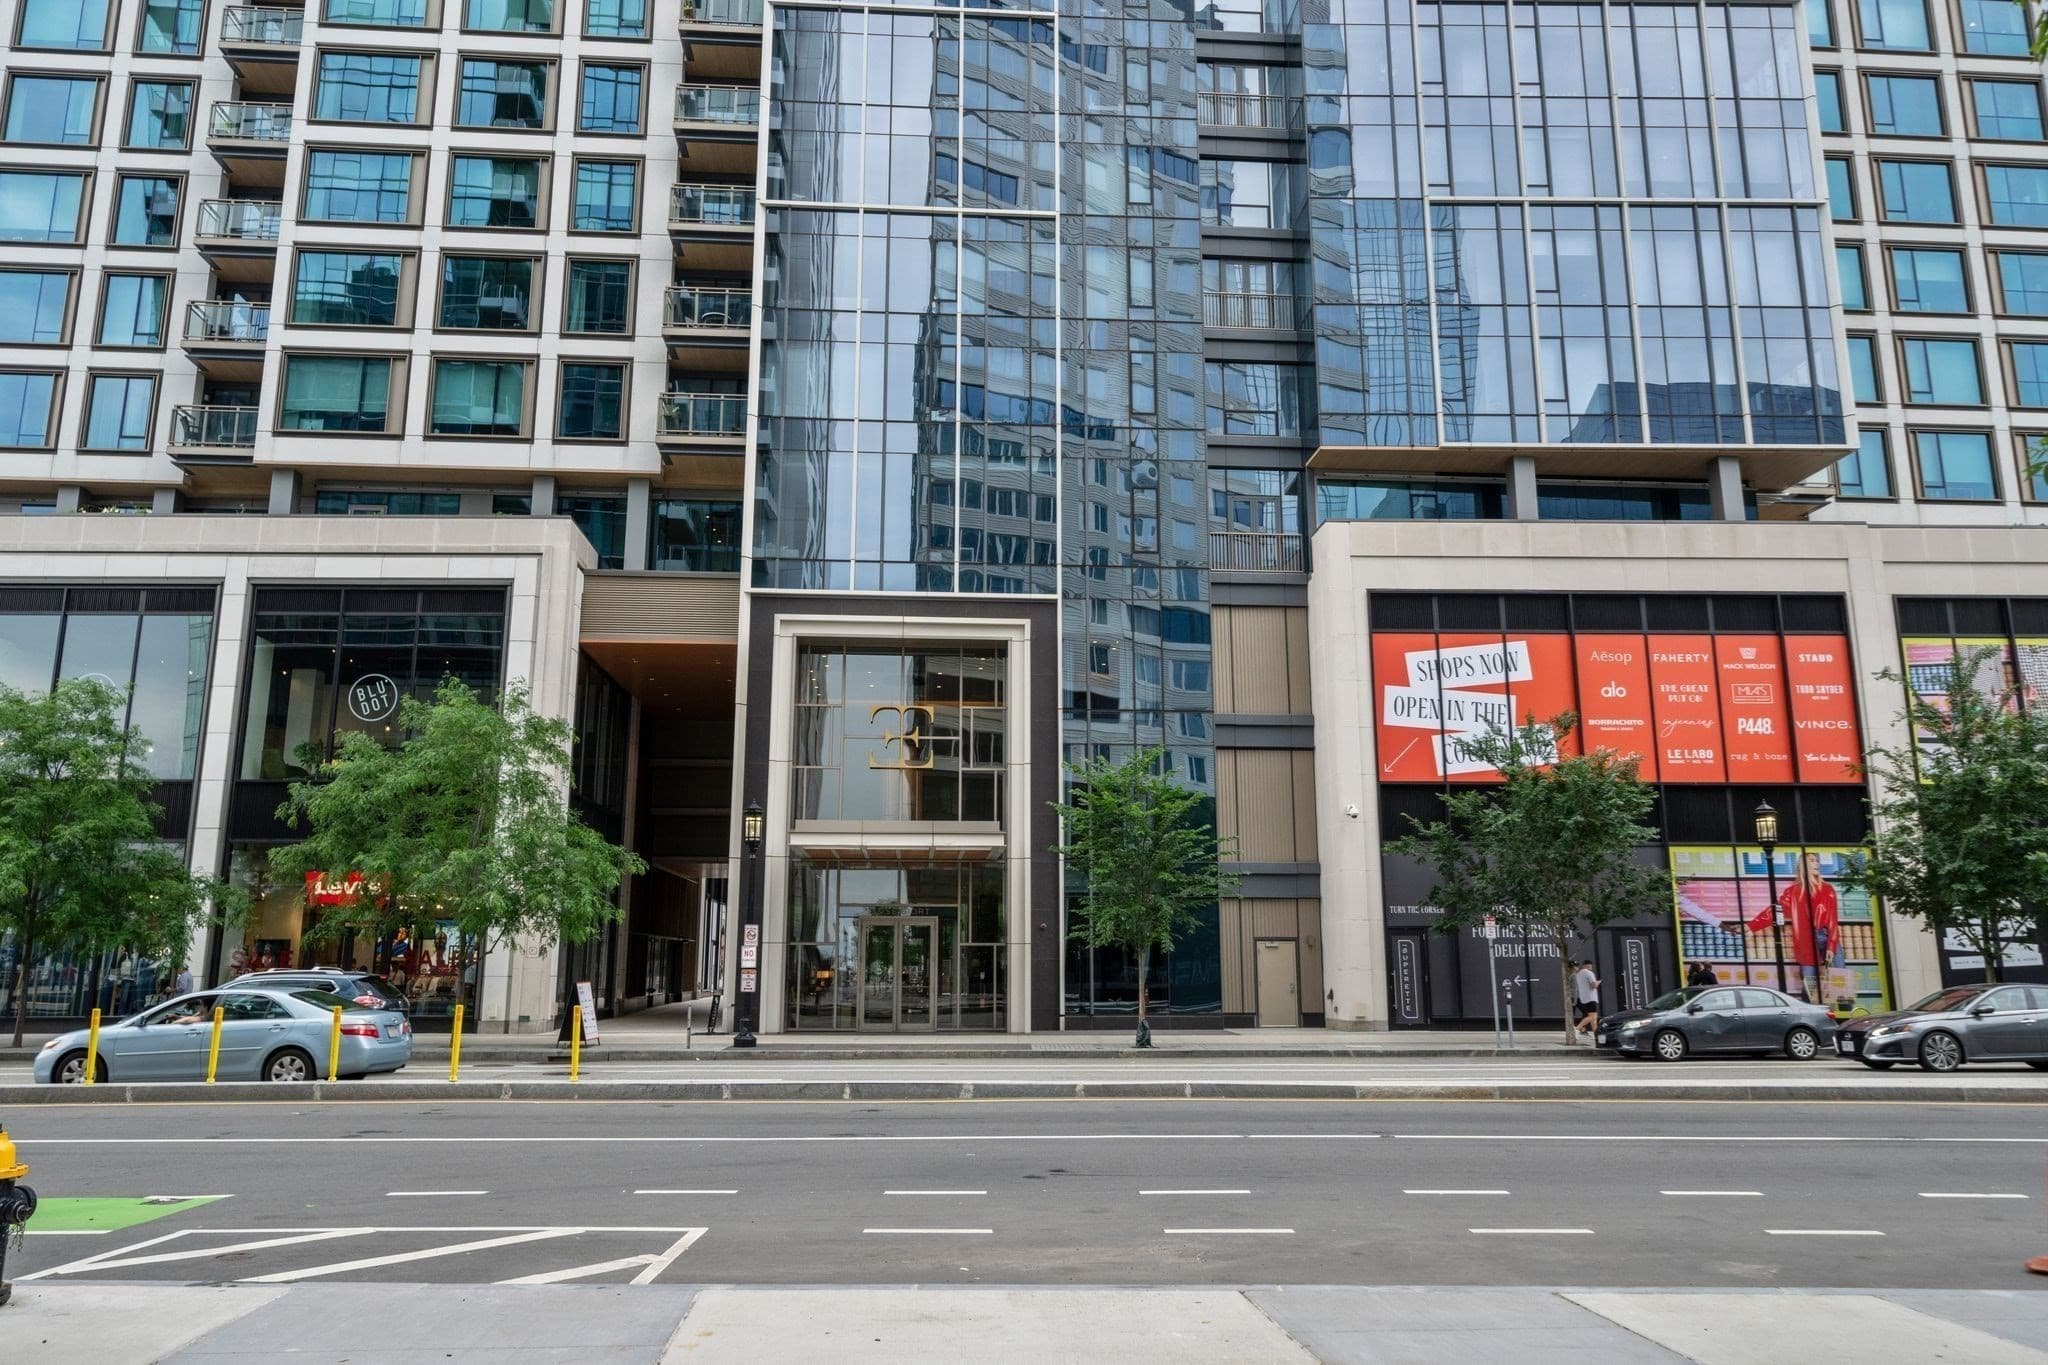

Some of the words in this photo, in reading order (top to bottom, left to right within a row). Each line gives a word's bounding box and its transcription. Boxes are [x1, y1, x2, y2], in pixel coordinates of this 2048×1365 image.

[1653, 653, 1709, 662] FAHERTY
[1417, 655, 1475, 681] SHOPS
[1479, 651, 1519, 676] NOW
[356, 680, 386, 701] BLU
[1601, 681, 1627, 697] alo
[361, 694, 388, 715] DOT
[1393, 696, 1441, 719] OPEN
[1446, 700, 1465, 721] IN
[1471, 701, 1507, 725] THE
[1667, 749, 1682, 758] LE
[1684, 749, 1714, 758] LABO
[1389, 905, 1406, 914] TURN
[744, 949, 754, 958] NO
